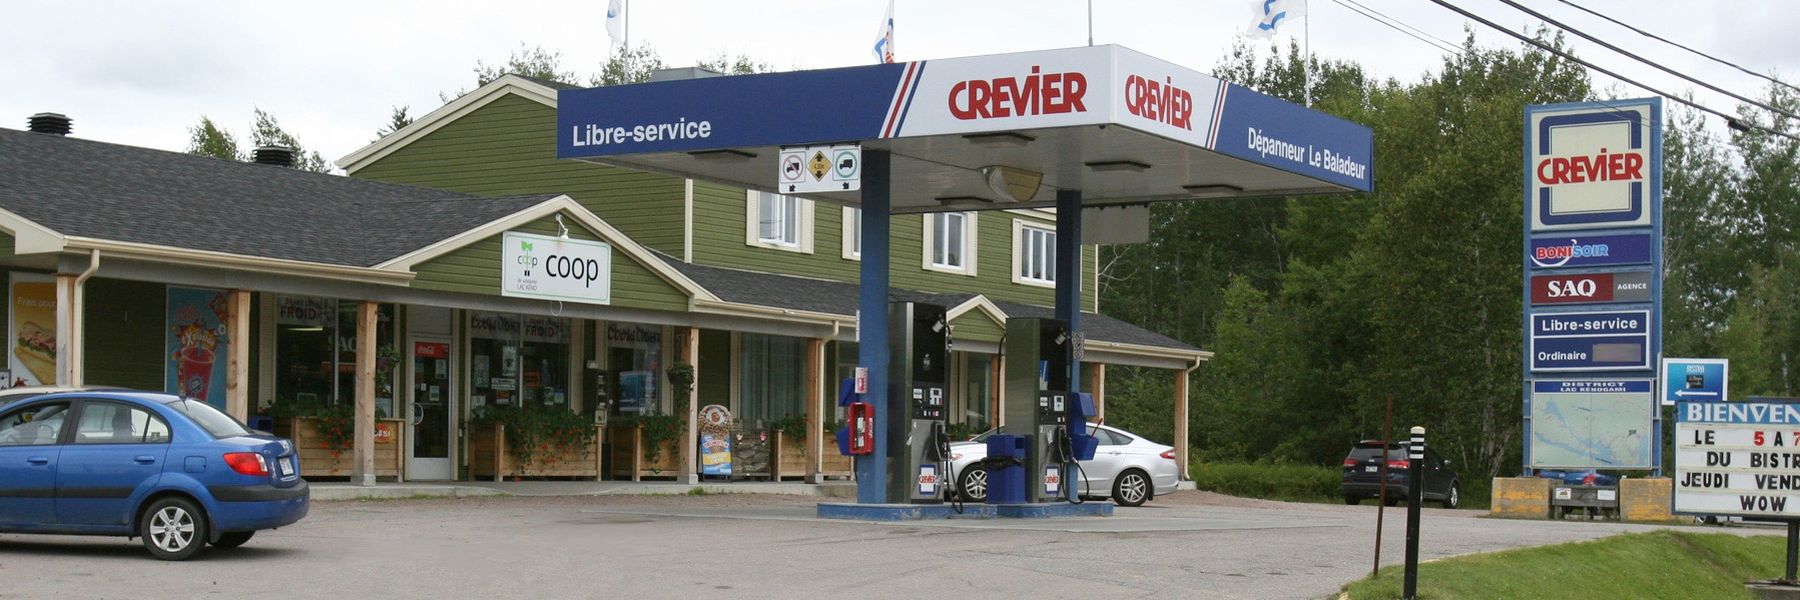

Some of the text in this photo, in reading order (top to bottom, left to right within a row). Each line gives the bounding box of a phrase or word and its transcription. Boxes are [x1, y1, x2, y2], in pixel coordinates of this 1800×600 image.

[948, 65, 1088, 120] CREVIER
[1125, 75, 1193, 131] CREVIER
[572, 117, 712, 147] Libre-service
[1247, 126, 1366, 181] Dépanneur Le Baladeur
[1537, 148, 1643, 185] CREVIER
[518, 255, 538, 269] coop
[546, 254, 599, 288] coop
[1547, 279, 1597, 298] SAQ
[280, 305, 317, 321] FROID
[1542, 317, 1638, 332] Libre-service
[1538, 350, 1587, 361] Ordinaire
[1687, 403, 1800, 423] BIENVEN
[1695, 430, 1715, 445] LE
[1754, 431, 1765, 446] 5
[1774, 431, 1783, 446] A
[1707, 451, 1731, 467] DU
[1681, 472, 1729, 489] JEUDI
[1740, 495, 1787, 512] WOW
